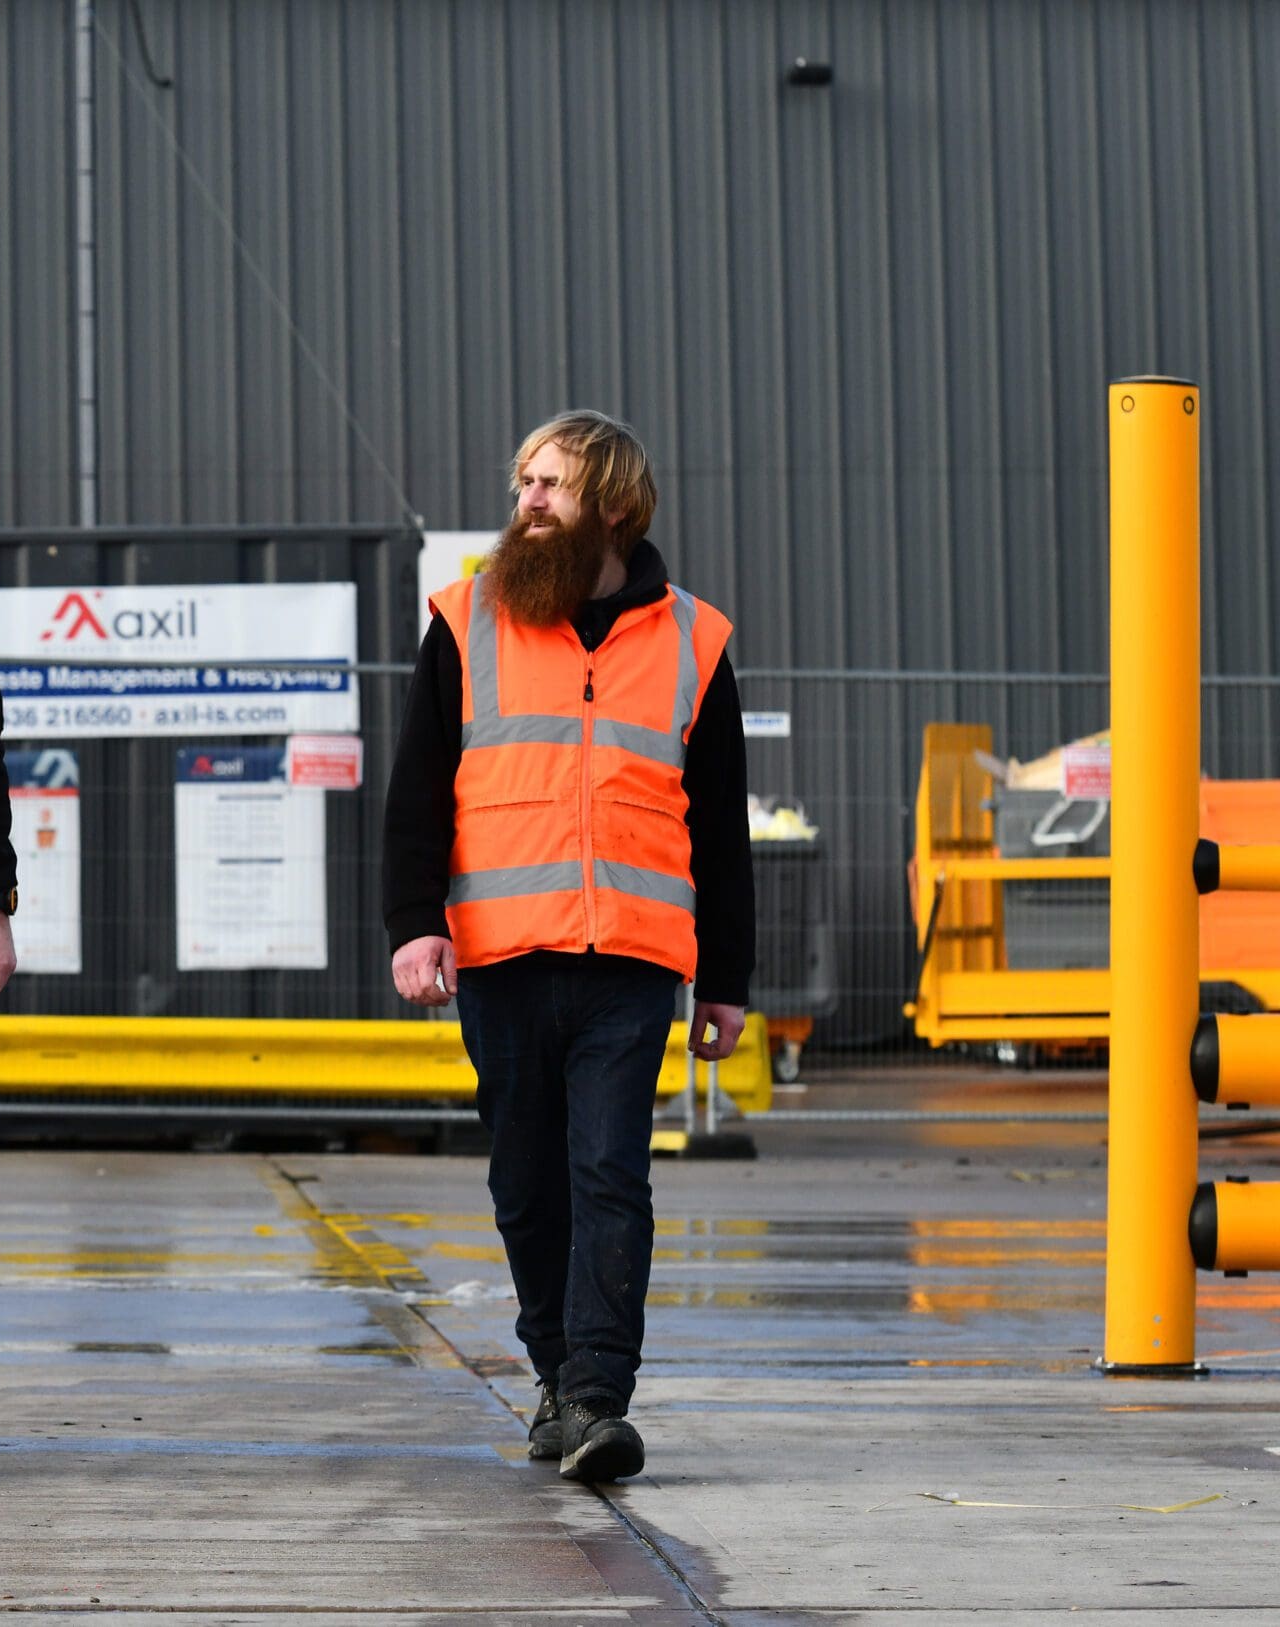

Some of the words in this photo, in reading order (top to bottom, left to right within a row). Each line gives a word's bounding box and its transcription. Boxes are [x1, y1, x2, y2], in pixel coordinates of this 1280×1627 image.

[113, 600, 196, 639] axil
[47, 666, 198, 693] Management
[4, 706, 38, 727] 36
[47, 706, 132, 727] 216560
